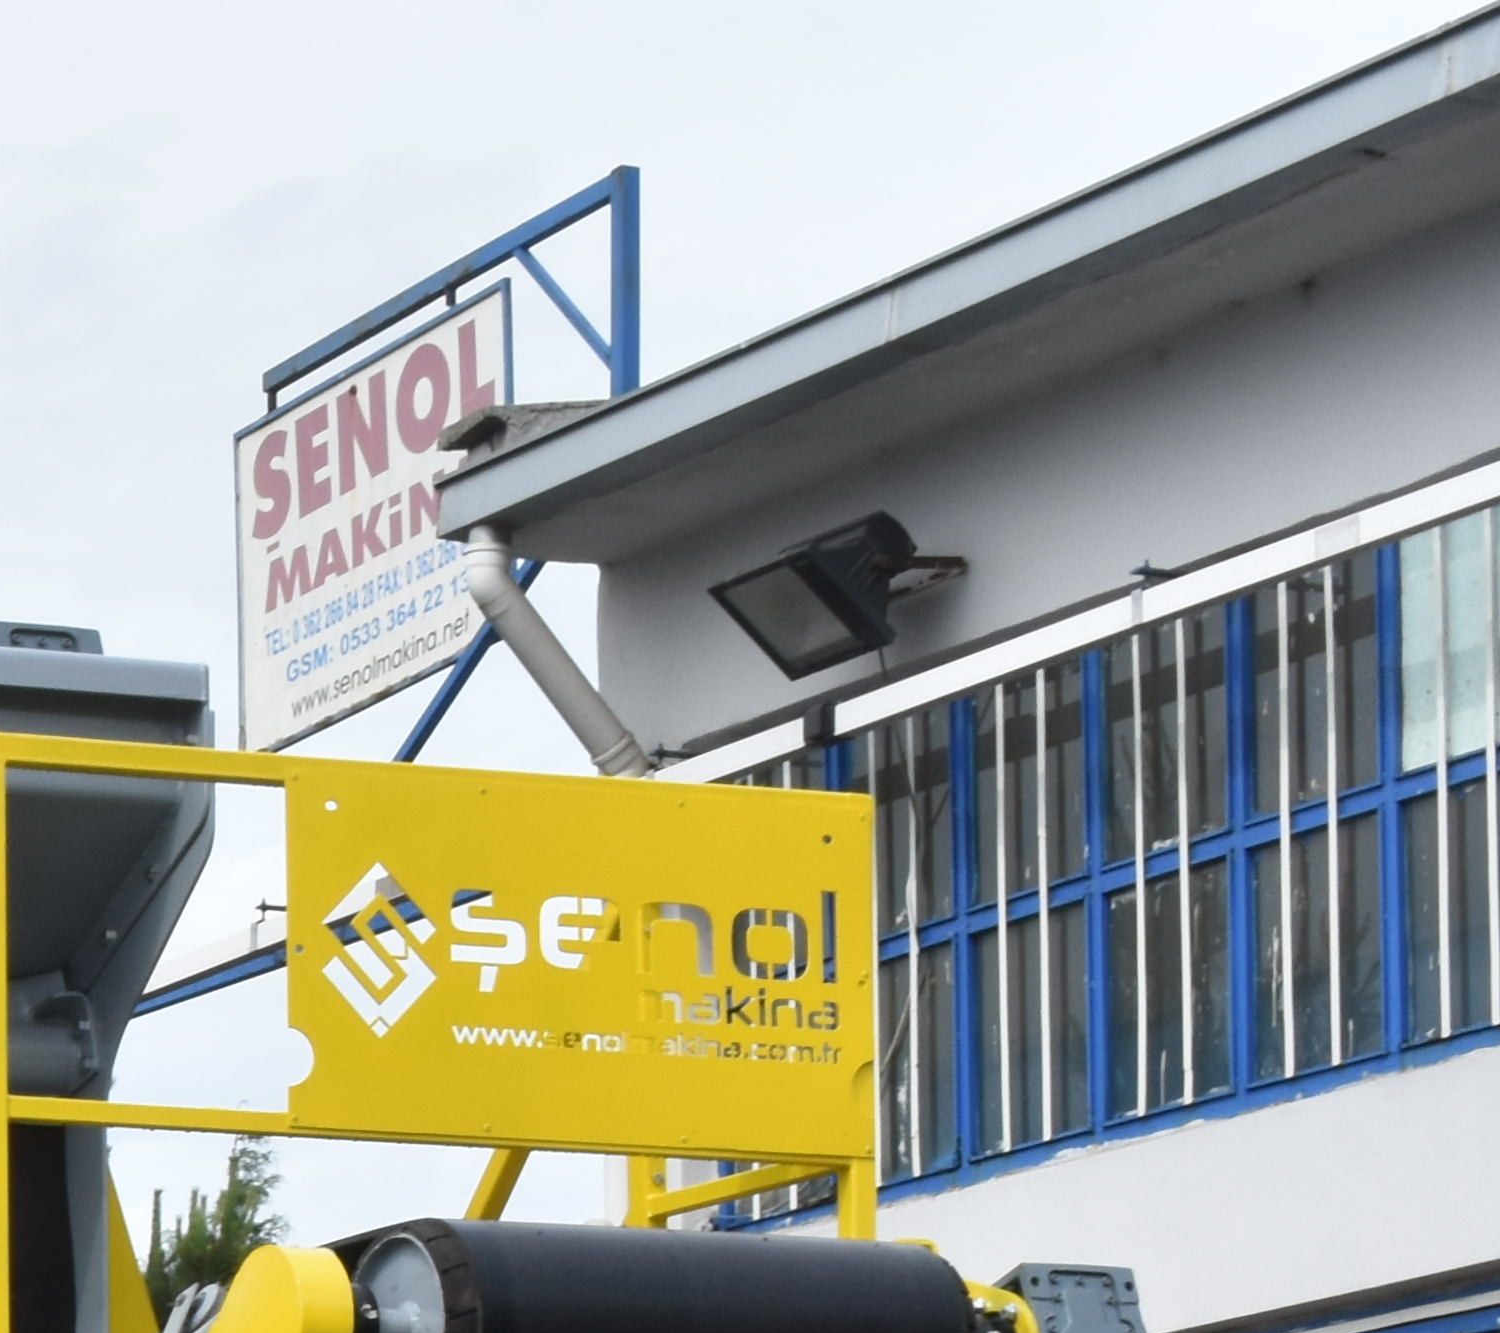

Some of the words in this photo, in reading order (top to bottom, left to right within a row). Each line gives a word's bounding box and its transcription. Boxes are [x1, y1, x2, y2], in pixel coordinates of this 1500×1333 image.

[286, 643, 334, 682] GSM:
[340, 616, 381, 656] 0533
[386, 597, 417, 632] 364
[423, 584, 444, 613] 22
[290, 607, 470, 718] www.senolmakina.net
[636, 986, 841, 1031] makina
